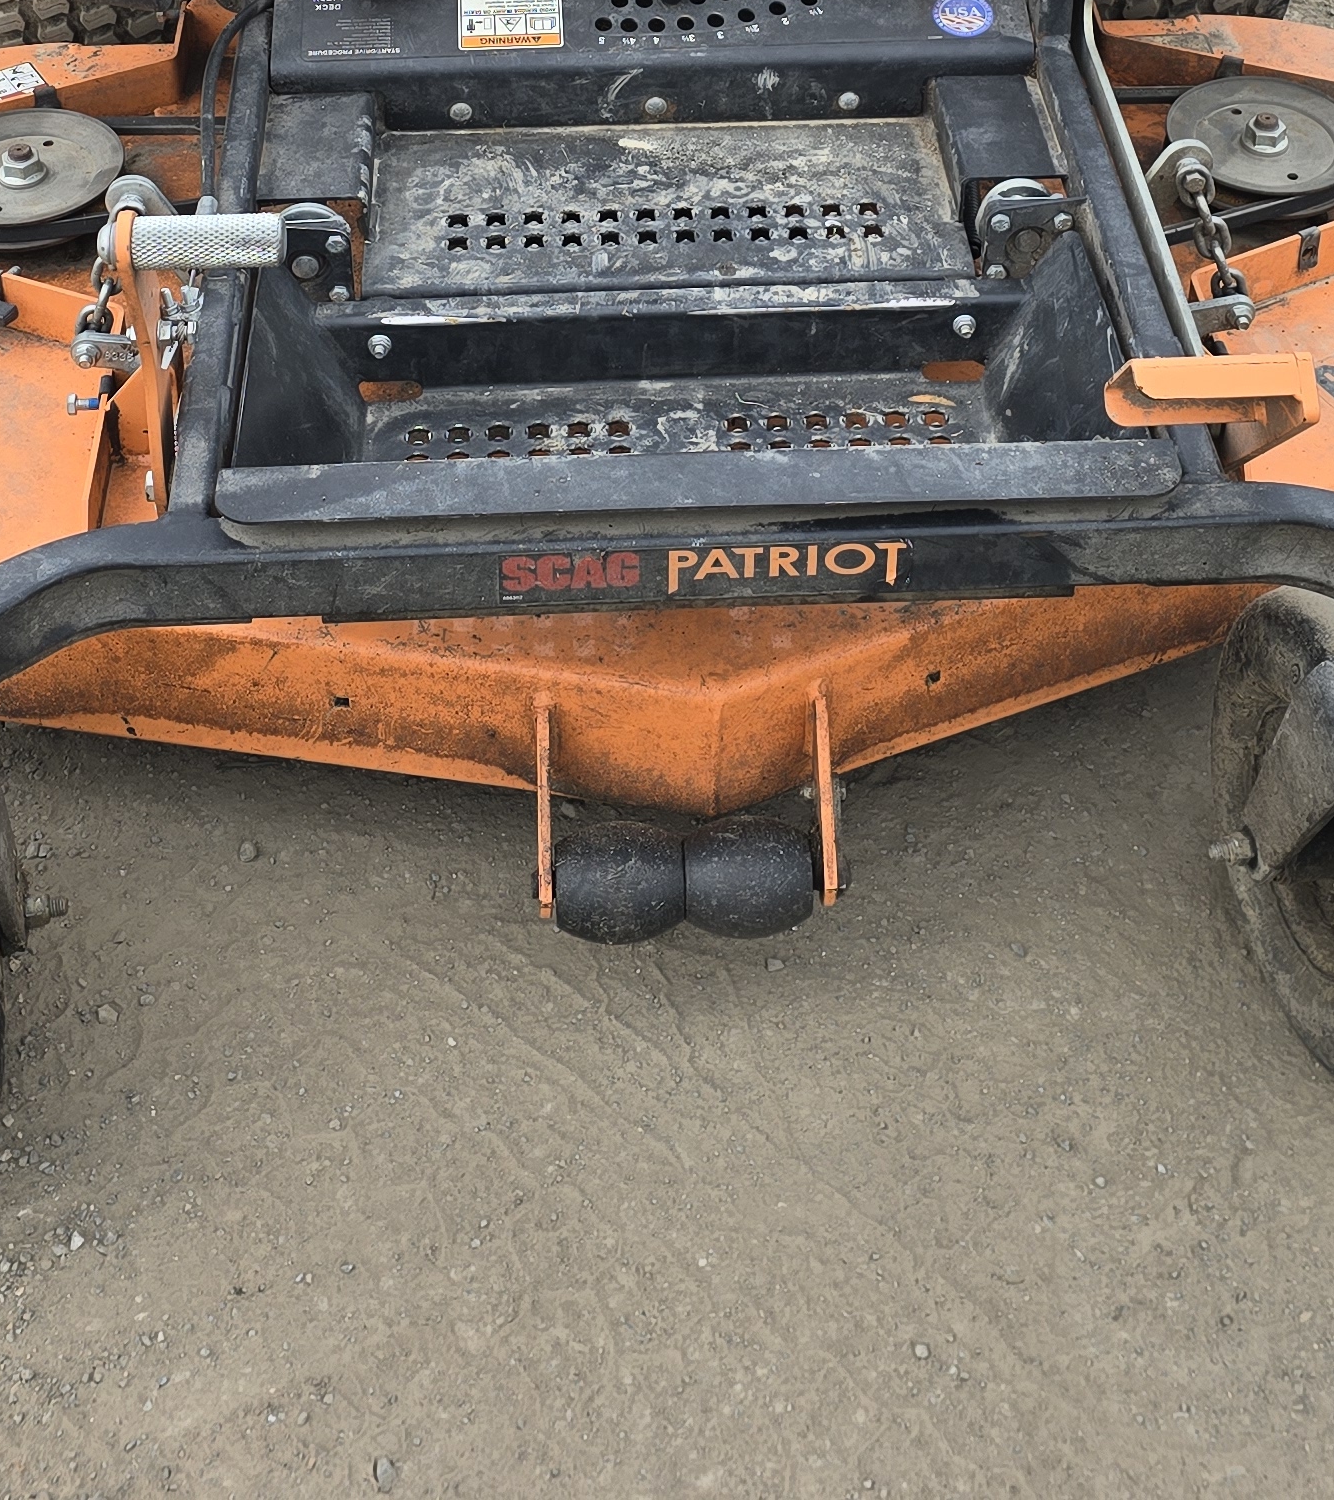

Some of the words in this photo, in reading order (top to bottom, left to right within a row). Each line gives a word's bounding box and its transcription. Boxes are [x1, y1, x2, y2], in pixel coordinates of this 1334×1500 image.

[944, 6, 983, 17] USA
[480, 36, 531, 44] WARNING
[717, 31, 724, 39] 3
[502, 551, 640, 591] SCAG
[668, 541, 907, 595] PATRIOT
